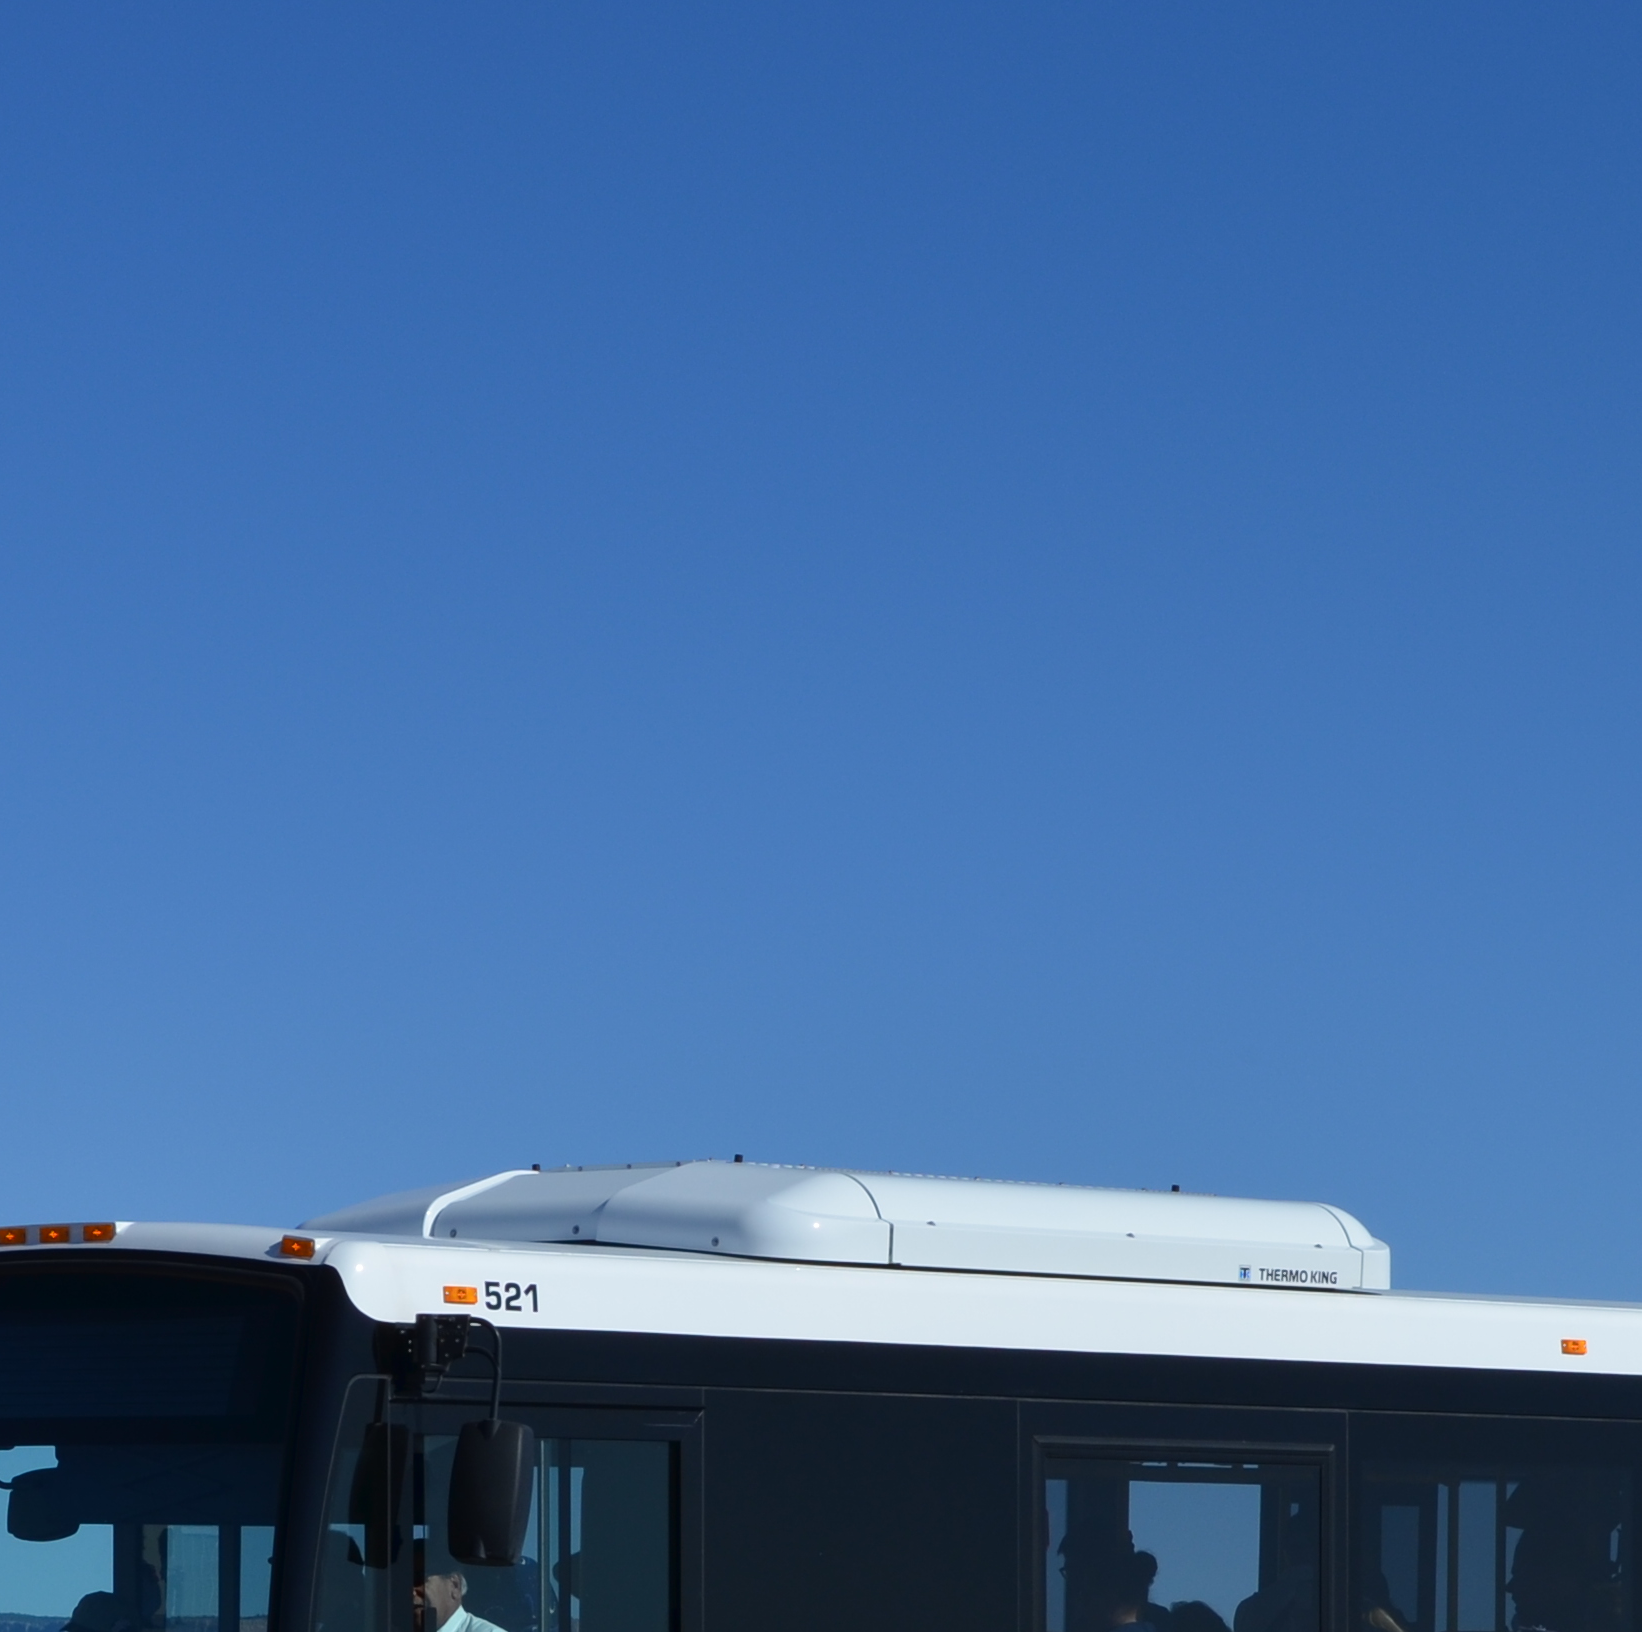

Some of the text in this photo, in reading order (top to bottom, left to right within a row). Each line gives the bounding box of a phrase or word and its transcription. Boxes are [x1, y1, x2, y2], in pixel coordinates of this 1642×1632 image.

[1259, 1268, 1307, 1283] THERMO
[1310, 1271, 1337, 1284] KING
[484, 1281, 538, 1312] 521
